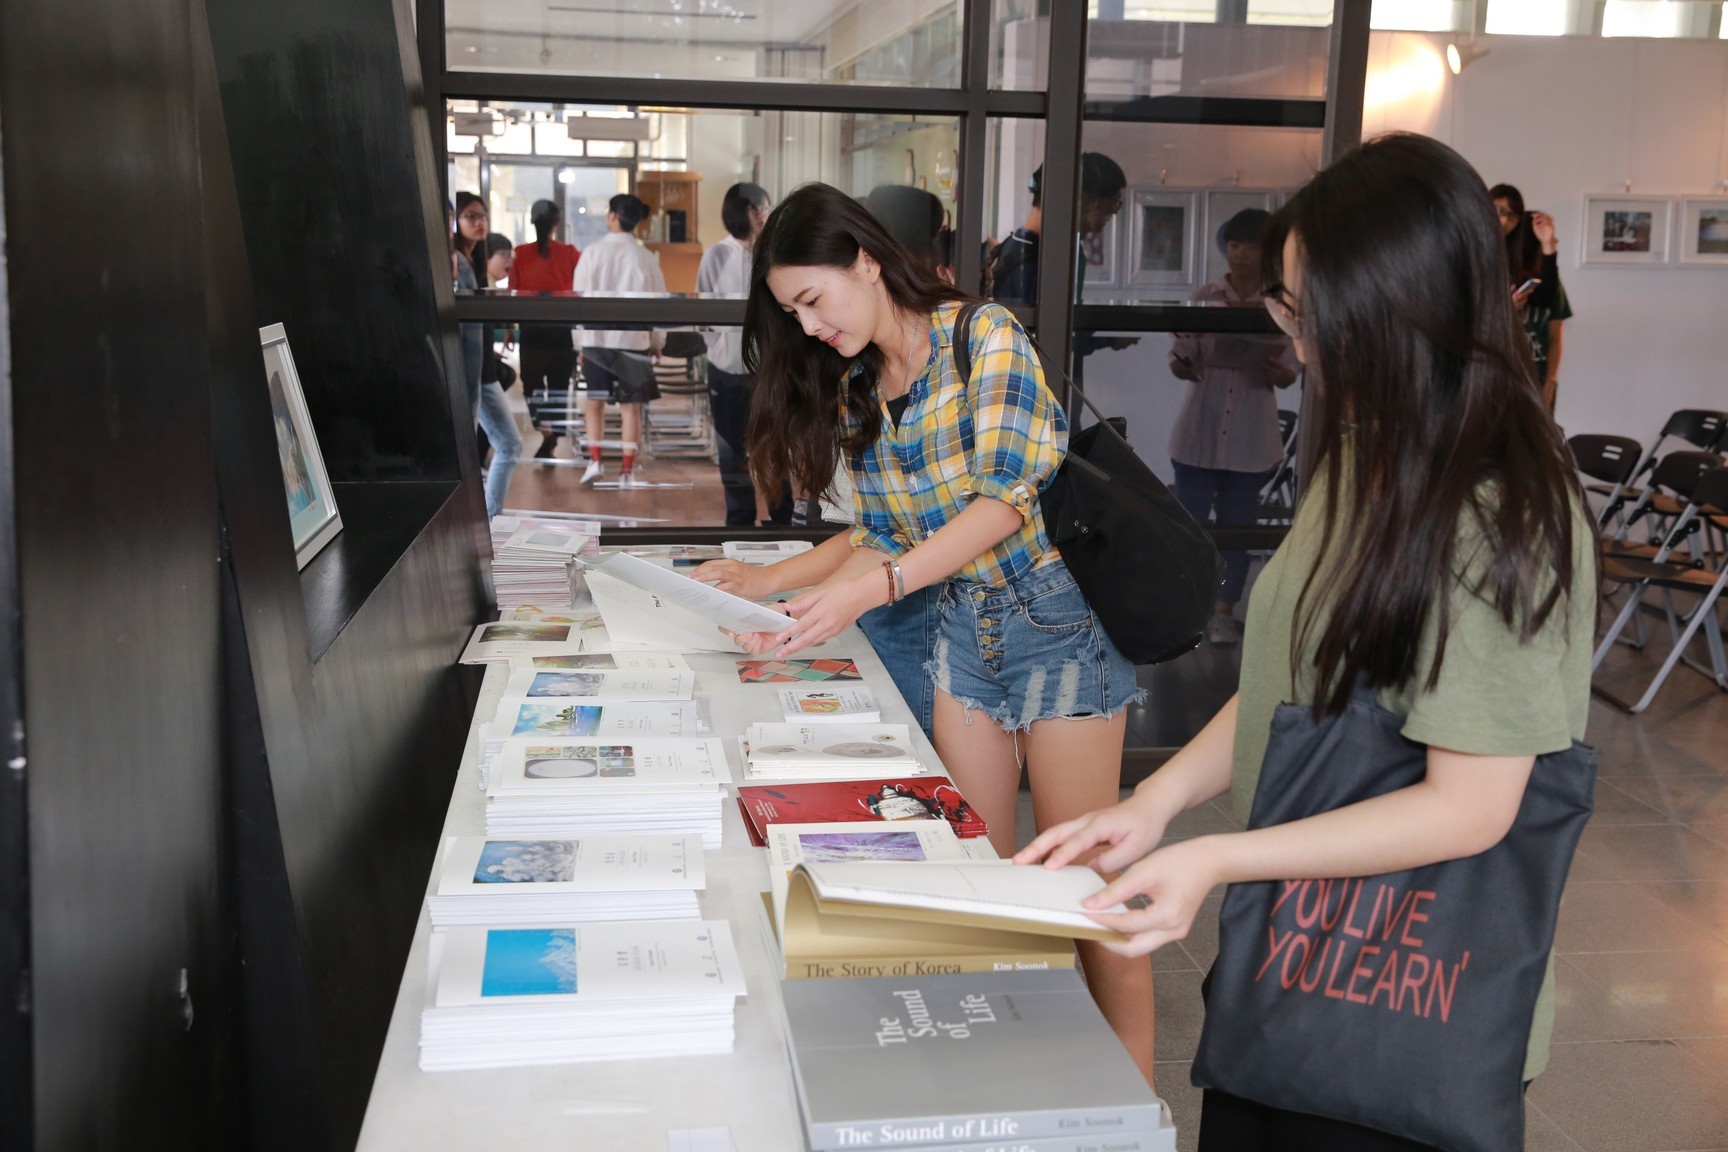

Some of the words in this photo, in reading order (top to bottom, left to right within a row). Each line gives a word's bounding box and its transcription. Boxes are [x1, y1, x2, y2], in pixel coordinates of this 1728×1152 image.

[804, 963, 835, 978] The
[841, 962, 886, 977] Story
[892, 961, 911, 976] of
[915, 960, 962, 976] Korea
[993, 961, 1013, 971] Kim
[1015, 960, 1049, 971] Soonok
[893, 989, 938, 1037] Sound
[960, 994, 997, 1023] Life
[875, 1017, 907, 1047] The
[936, 1021, 971, 1039] of
[835, 1126, 873, 1145] The
[880, 1121, 944, 1143] Sound
[951, 1119, 976, 1138] of
[980, 1117, 1018, 1138] Life
[1058, 1118, 1081, 1129] Kim
